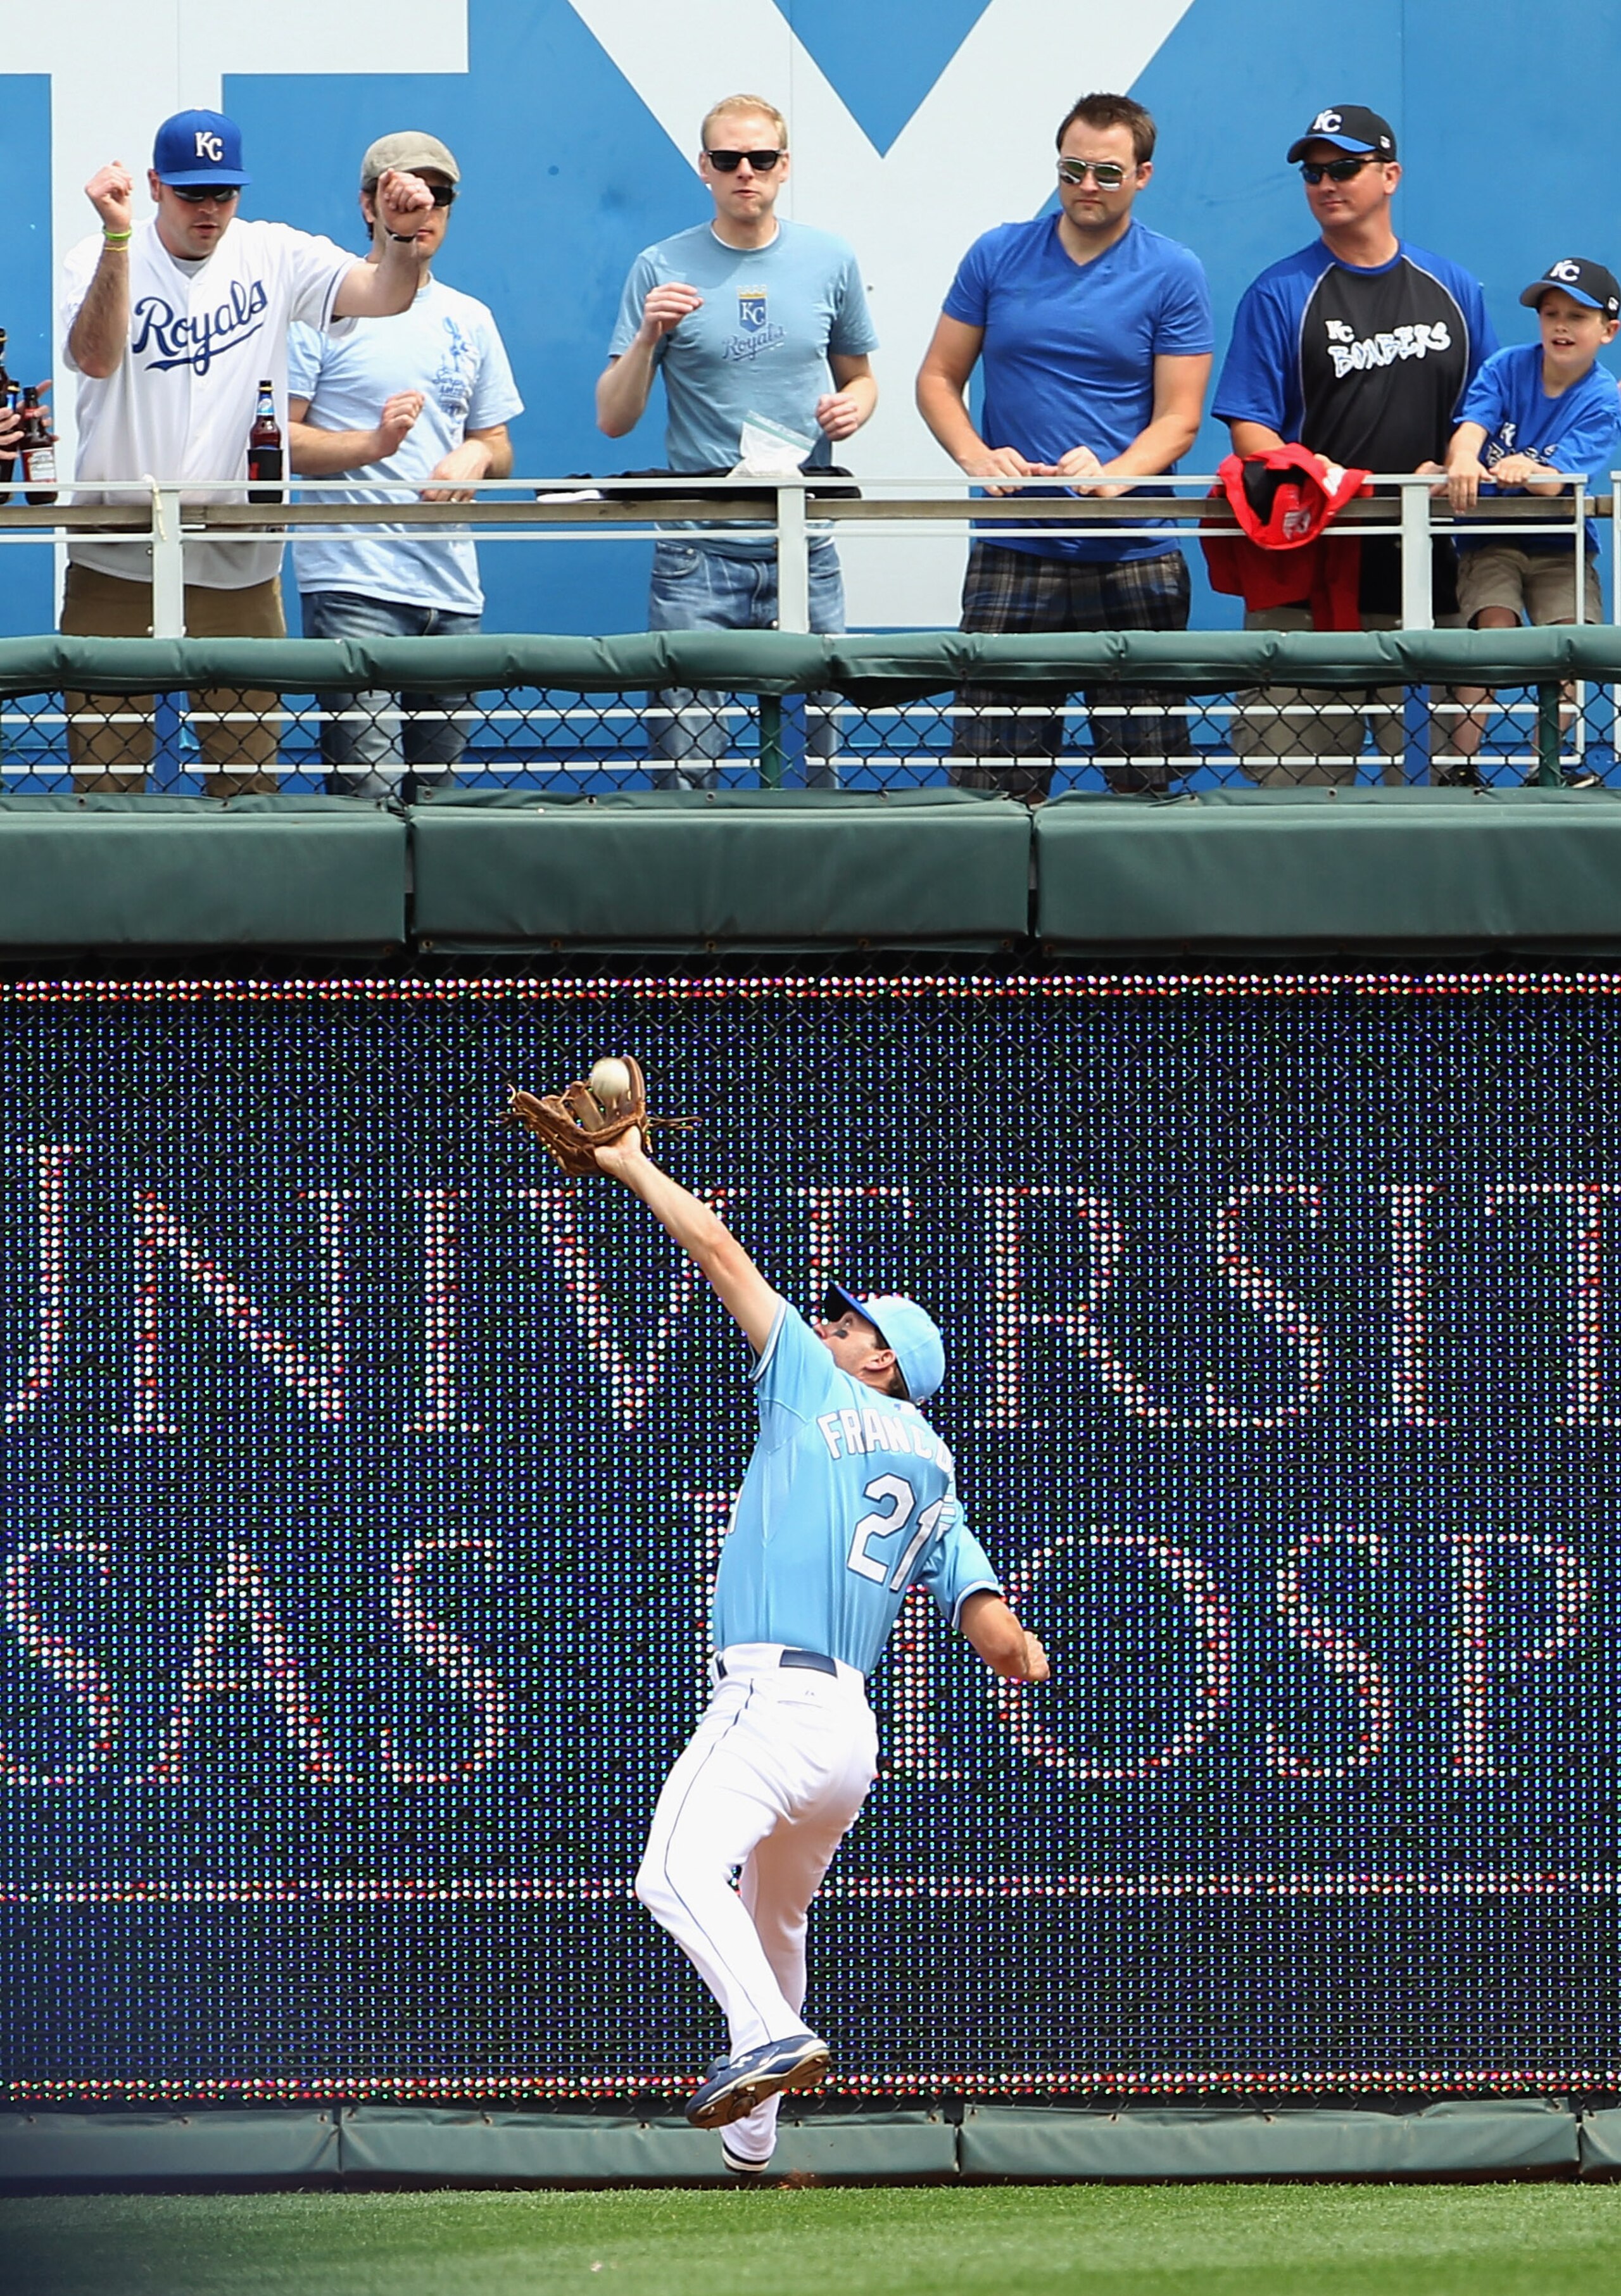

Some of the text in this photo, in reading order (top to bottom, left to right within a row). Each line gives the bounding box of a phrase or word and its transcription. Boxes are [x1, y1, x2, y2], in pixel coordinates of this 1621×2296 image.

[1313, 109, 1342, 133] KC
[194, 132, 223, 161] KC
[1549, 260, 1580, 282] KC
[740, 301, 765, 325] KC
[131, 279, 268, 377] Royals
[722, 322, 786, 361] Royals
[1325, 320, 1355, 343] KC
[1327, 321, 1451, 379] BOMBERS
[847, 1472, 944, 1593] 21
